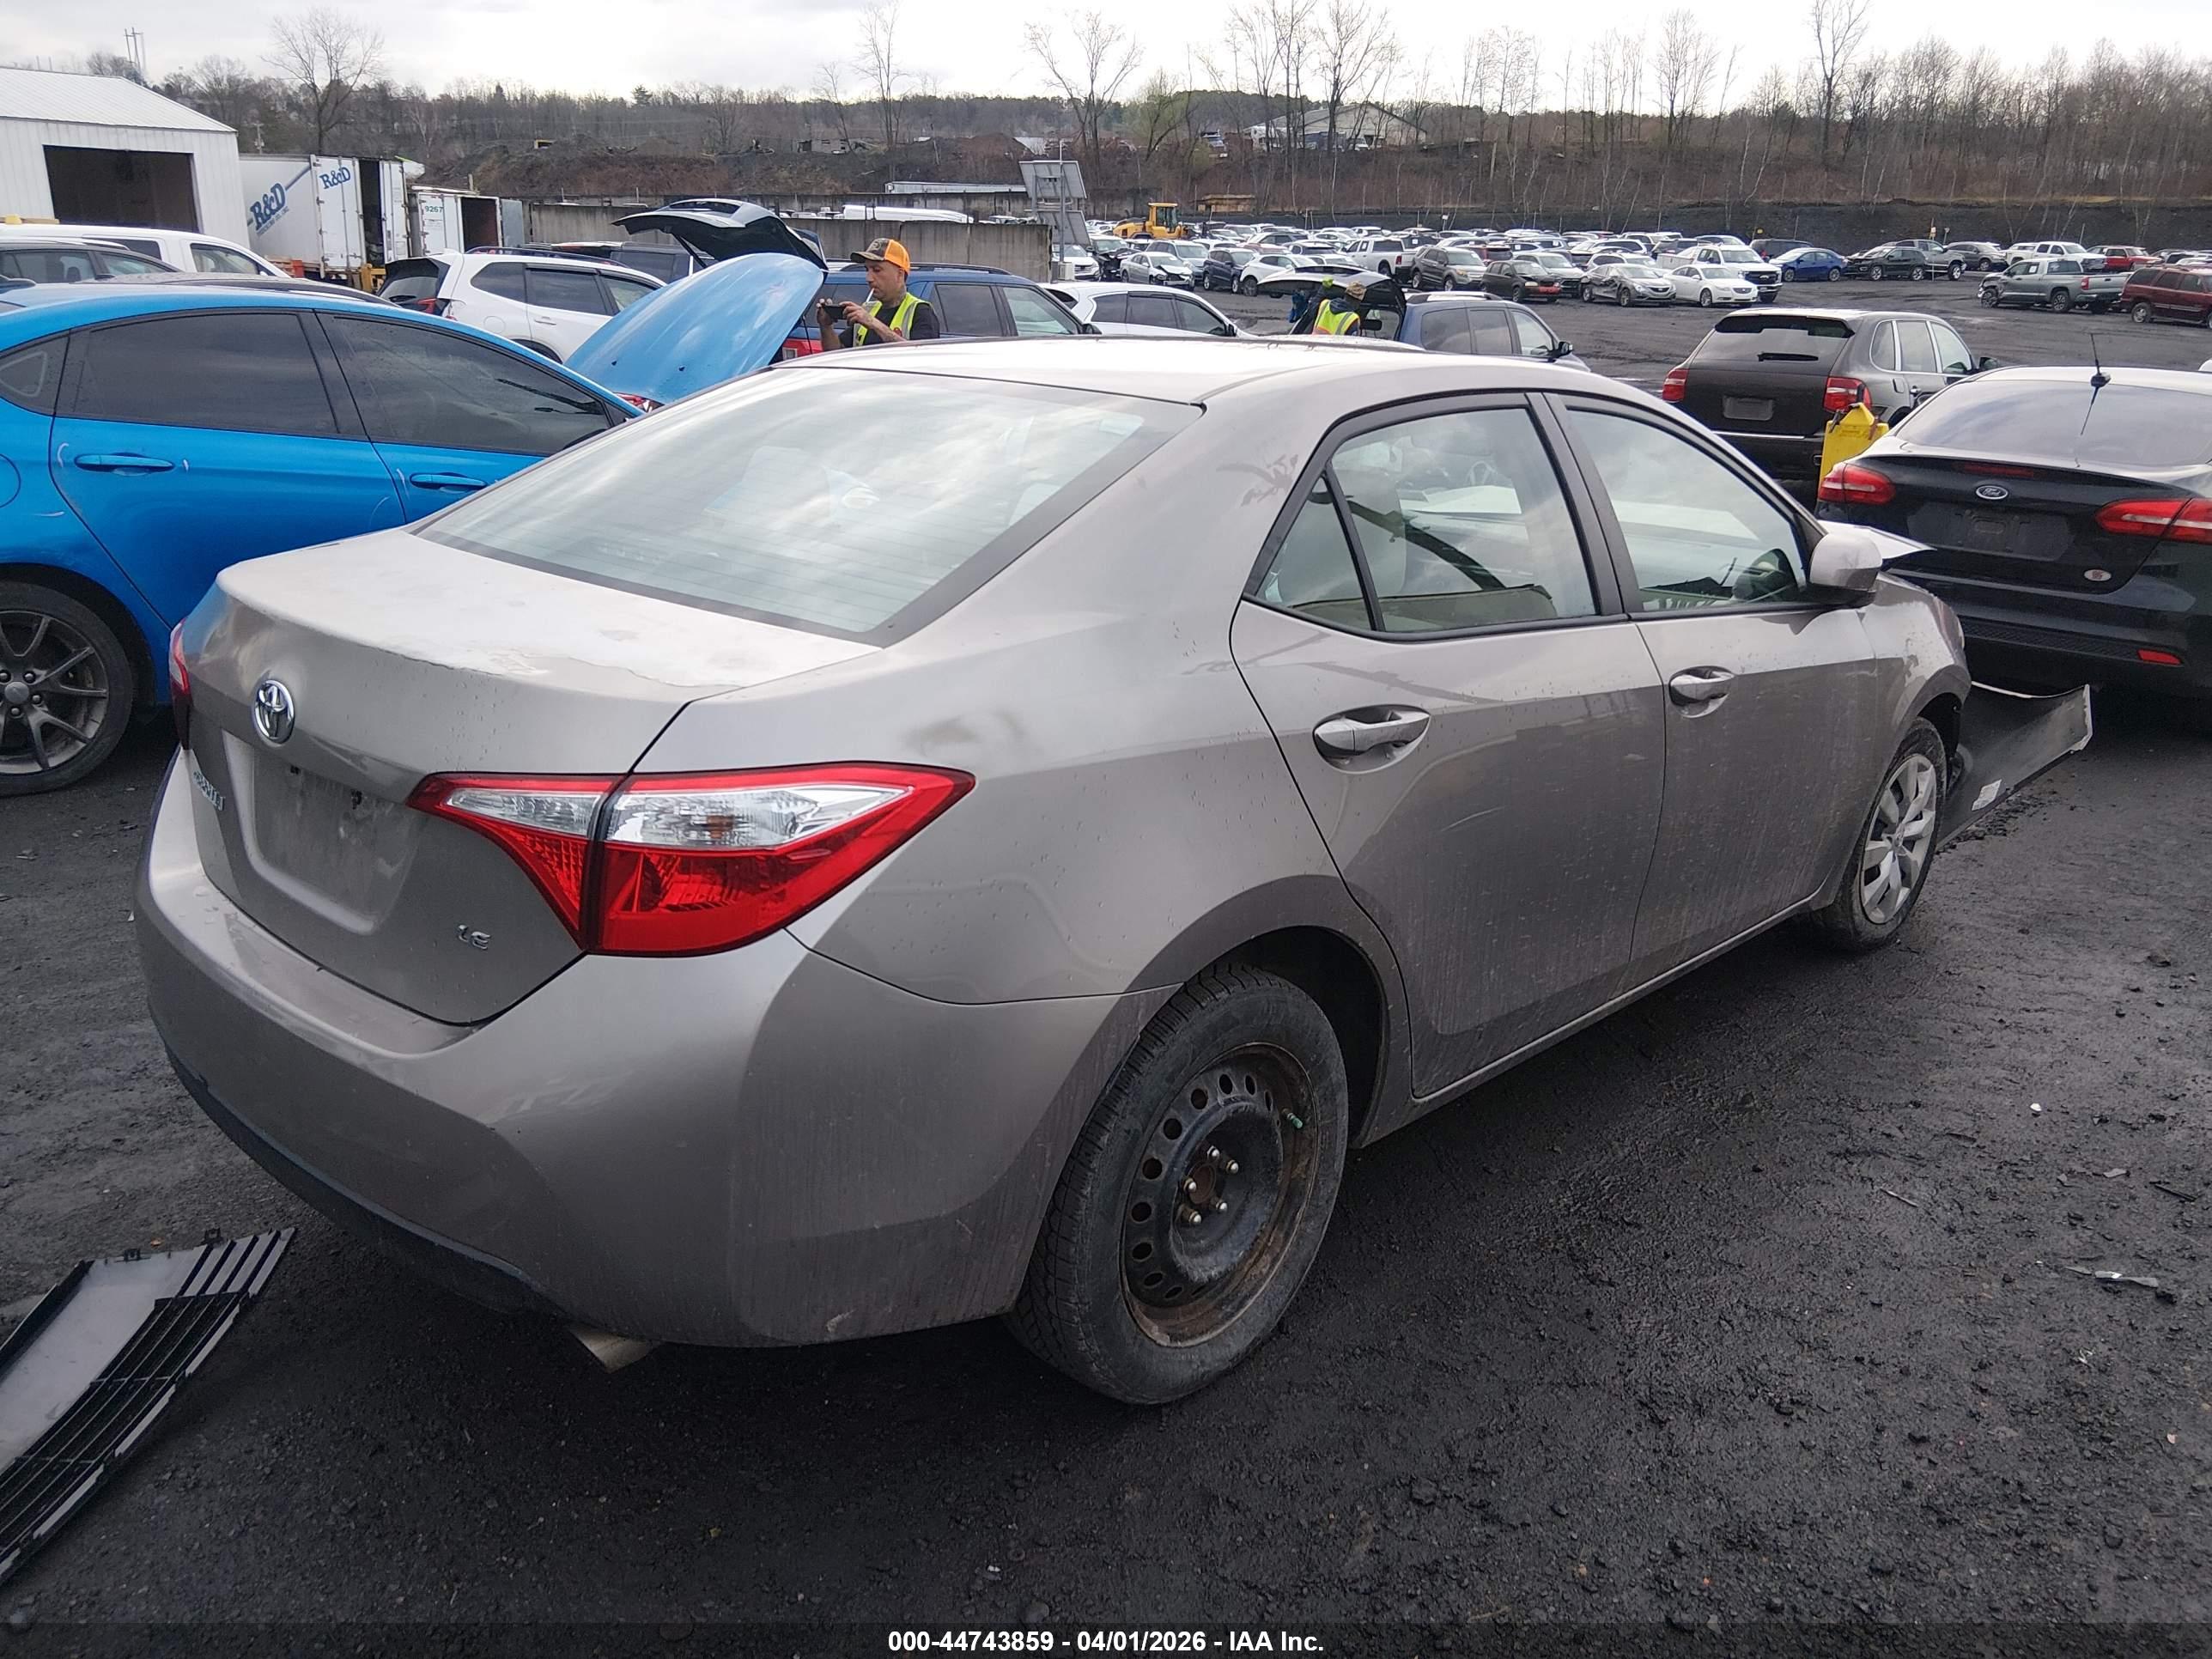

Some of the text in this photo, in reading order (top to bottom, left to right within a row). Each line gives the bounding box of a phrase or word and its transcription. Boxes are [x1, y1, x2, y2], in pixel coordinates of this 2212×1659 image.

[319, 167, 351, 189] R&D
[250, 182, 286, 231] R&D
[424, 205, 444, 214] 9267
